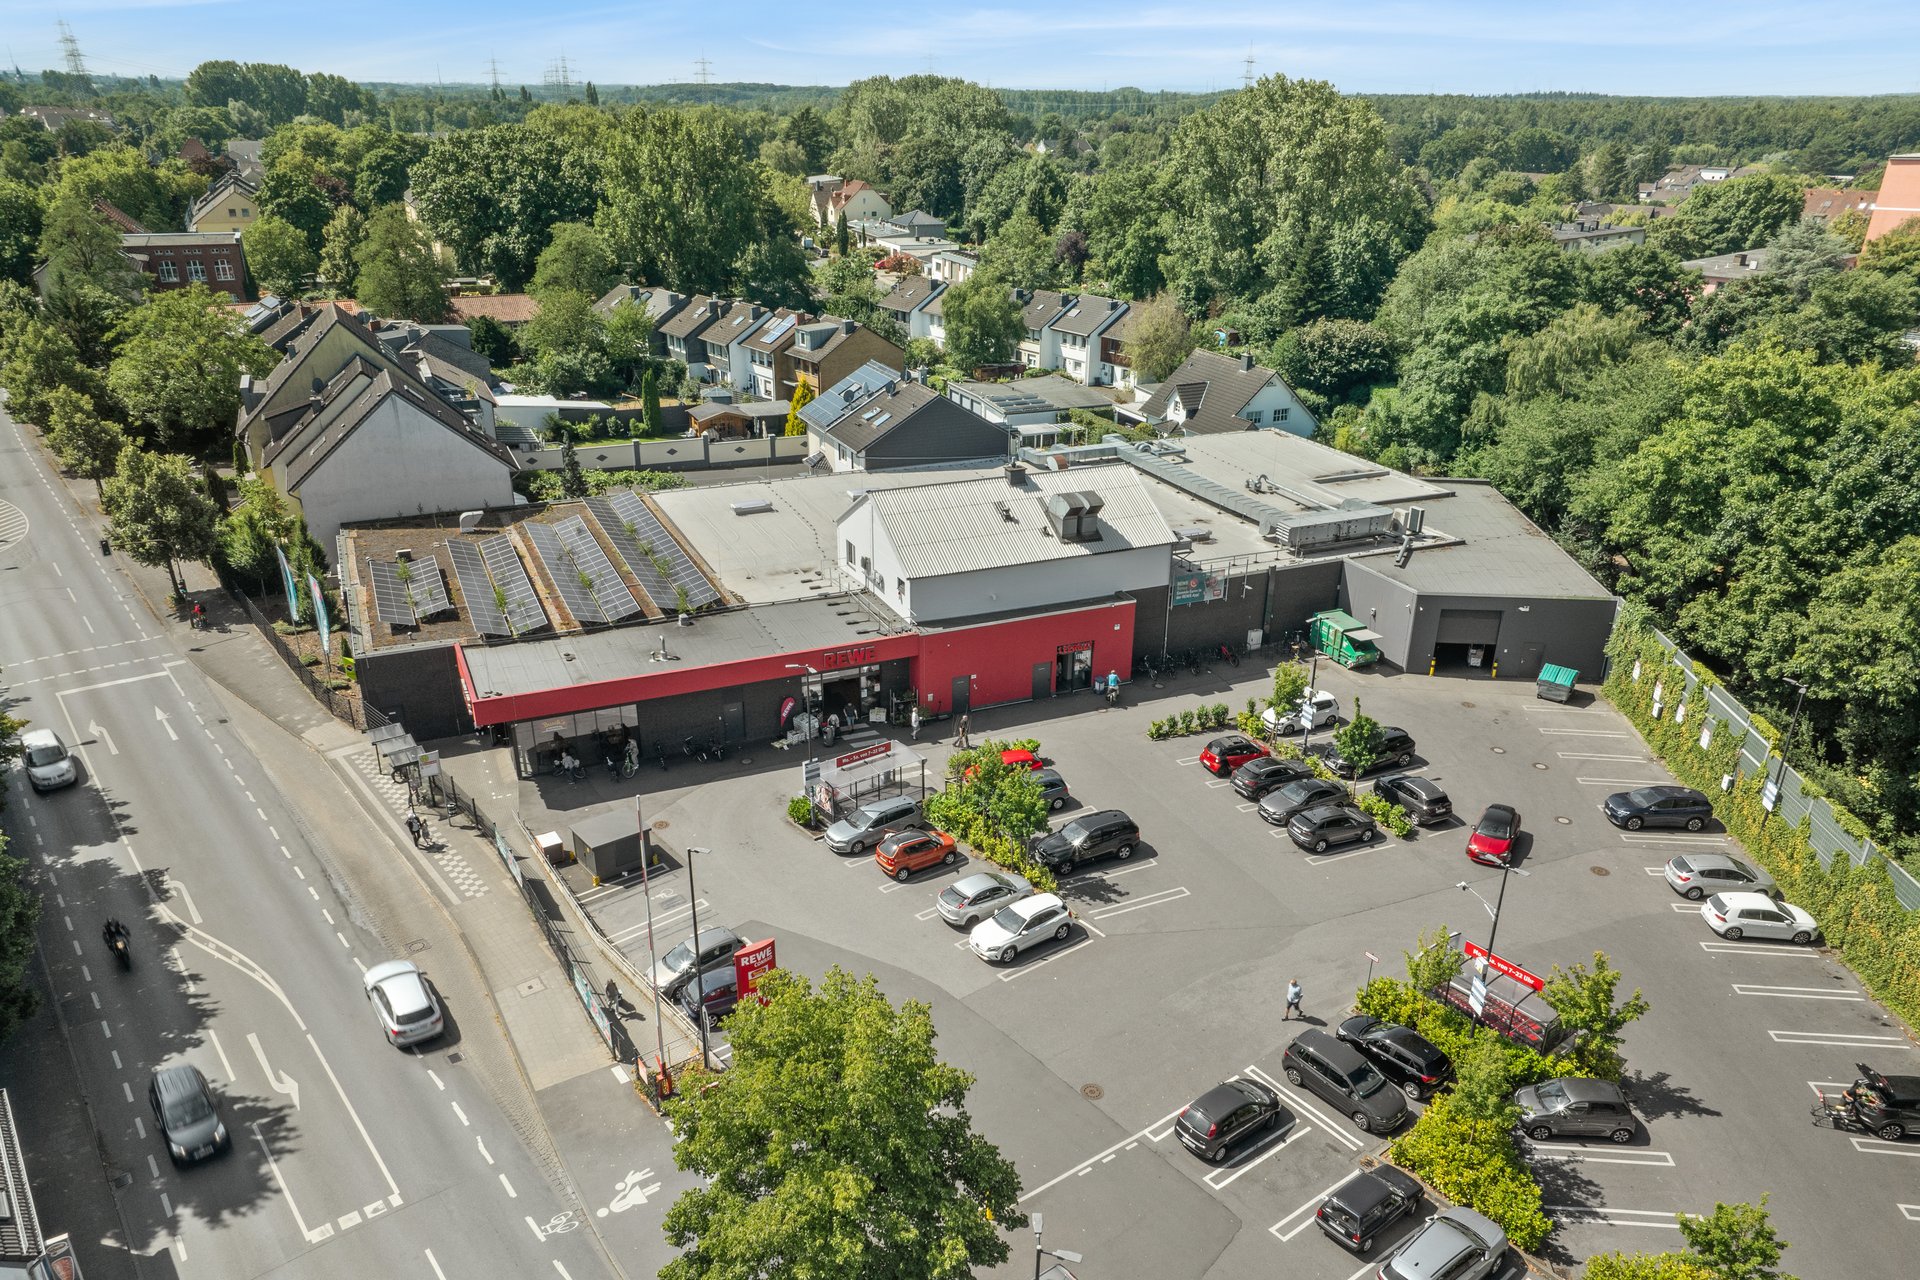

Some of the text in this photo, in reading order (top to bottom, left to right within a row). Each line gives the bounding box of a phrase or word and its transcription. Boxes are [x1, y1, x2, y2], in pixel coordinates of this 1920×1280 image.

[824, 646, 878, 668] REWE
[741, 946, 772, 967] REWE
[1497, 962, 1508, 971] von
[1523, 975, 1535, 984] Uhr
